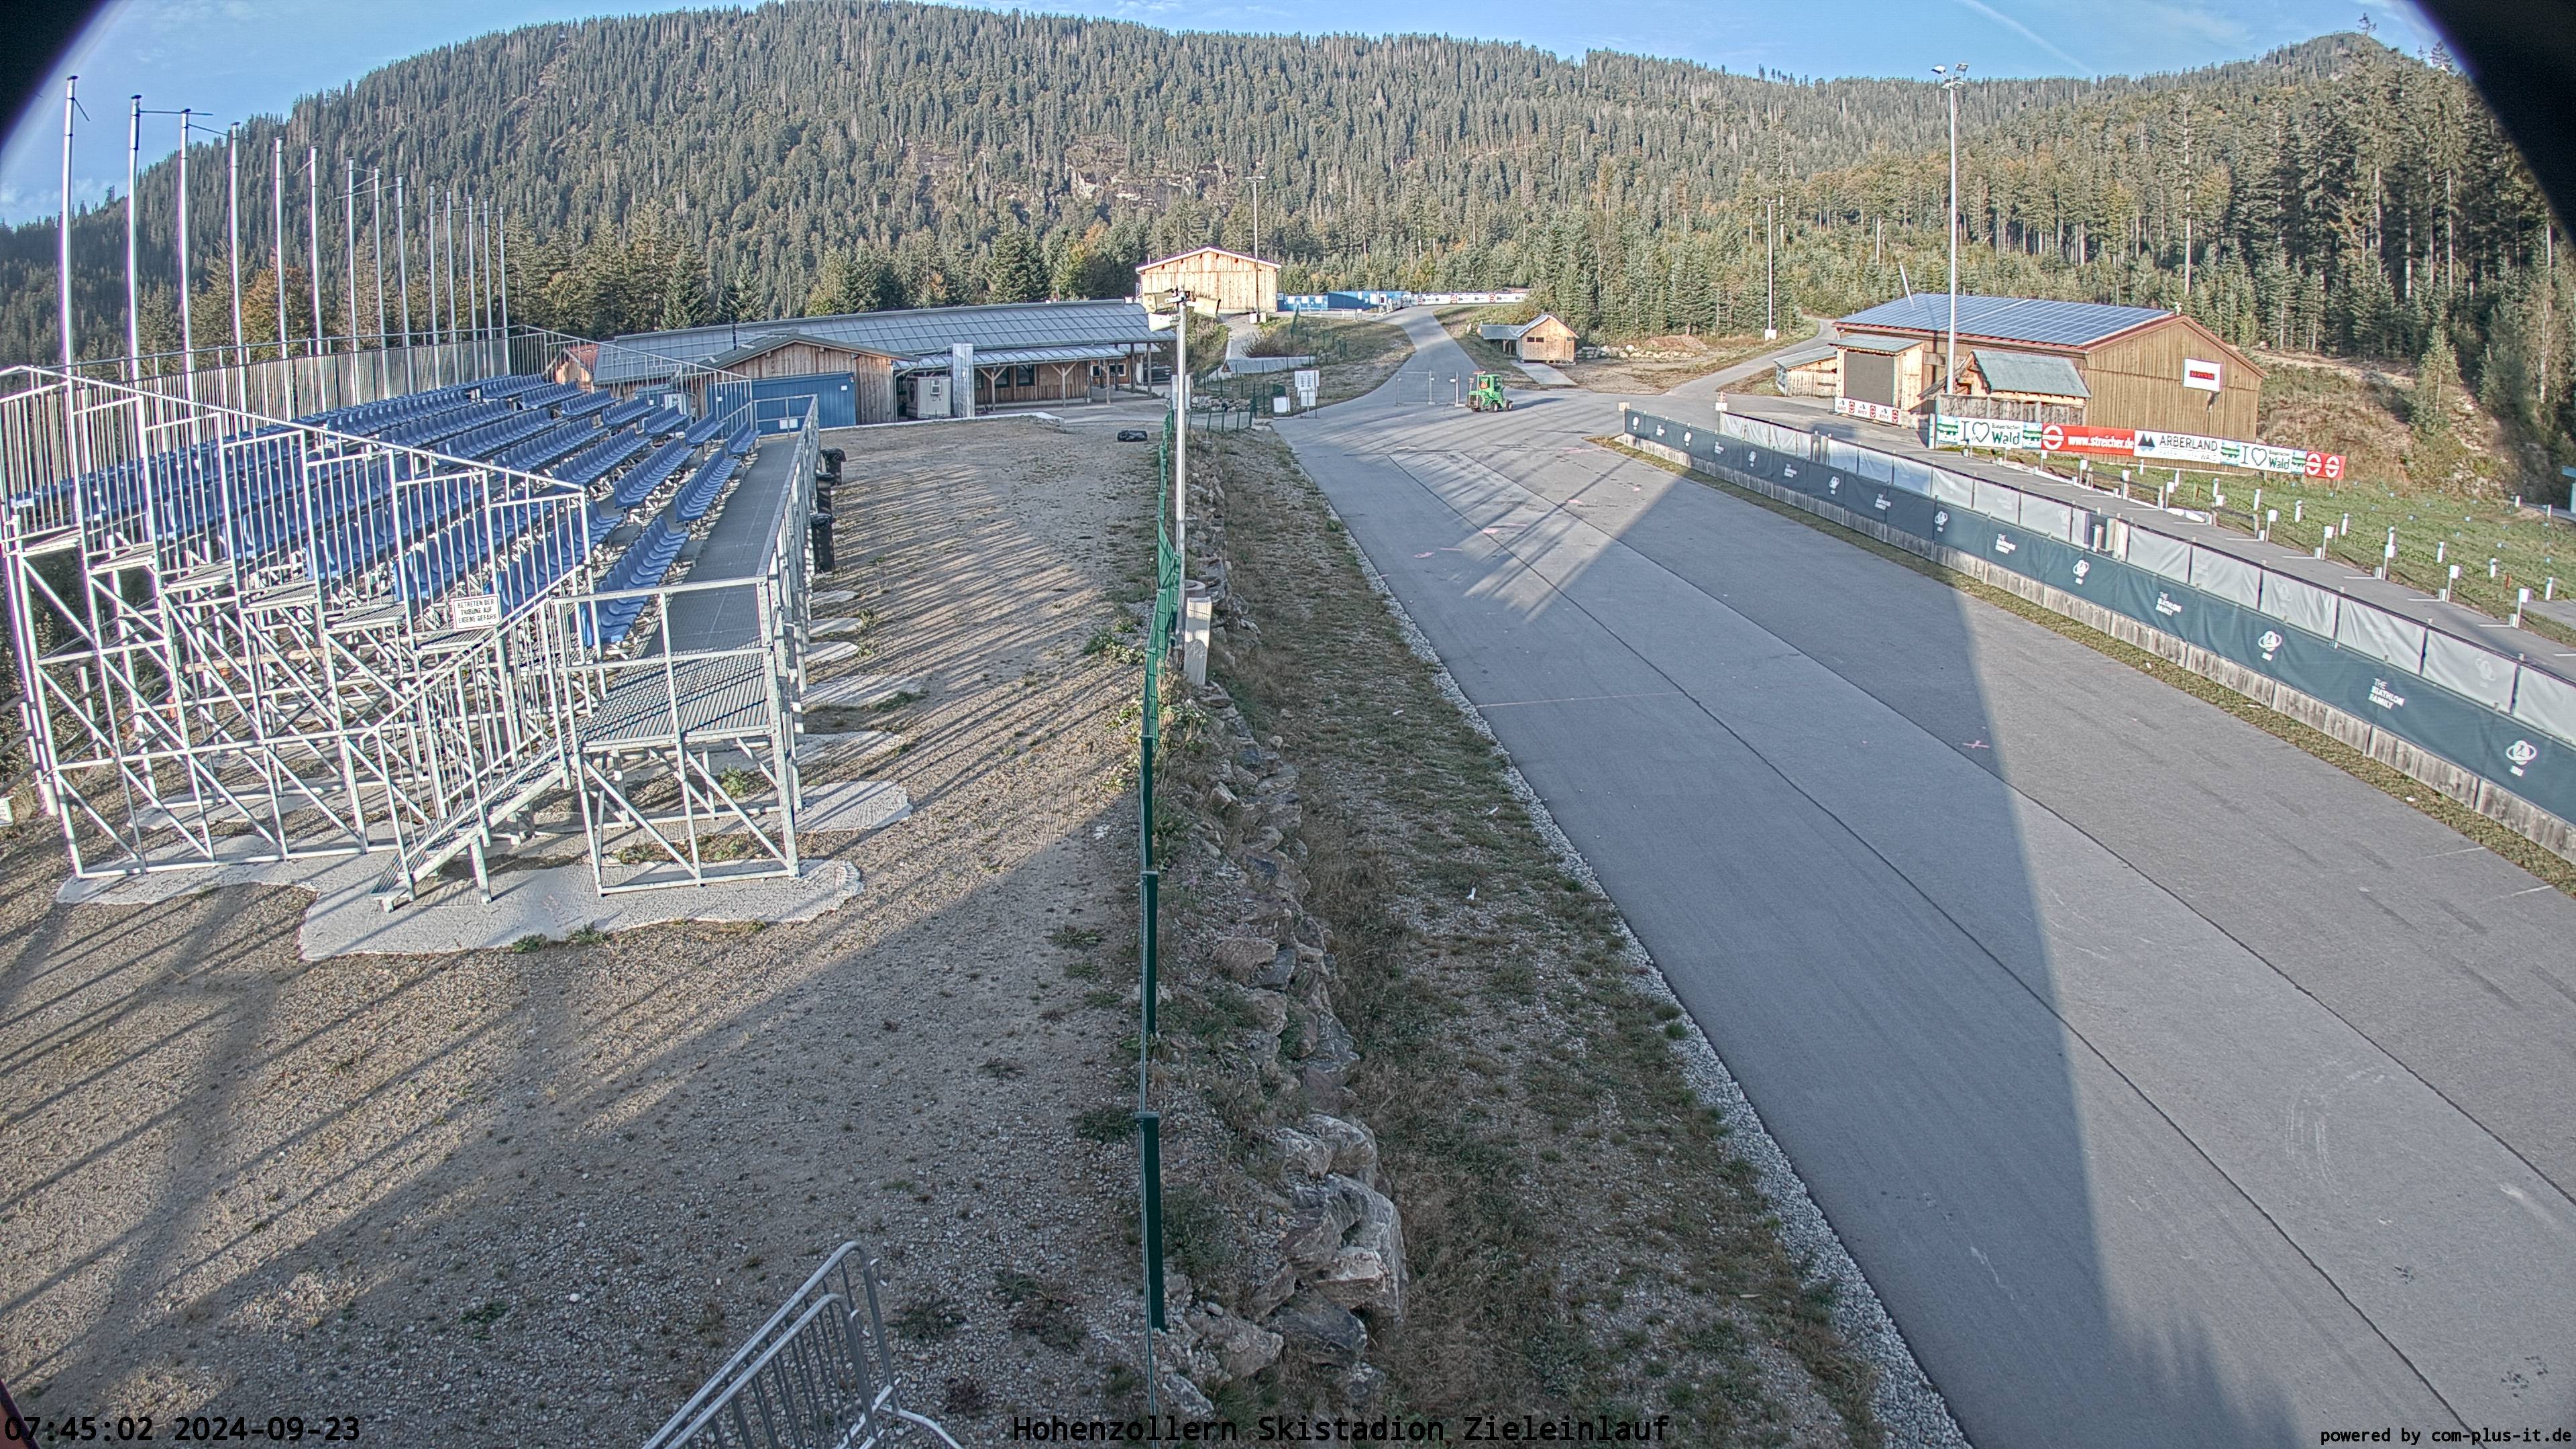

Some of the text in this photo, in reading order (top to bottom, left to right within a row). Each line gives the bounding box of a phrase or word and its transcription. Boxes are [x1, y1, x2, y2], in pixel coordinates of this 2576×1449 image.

[1991, 431, 2021, 445] Wald
[2068, 435, 2134, 449] www.streicher.de
[2159, 435, 2218, 451] ARBERLAND
[2268, 457, 2290, 470] Wald
[2371, 686, 2405, 707] BIATHLON
